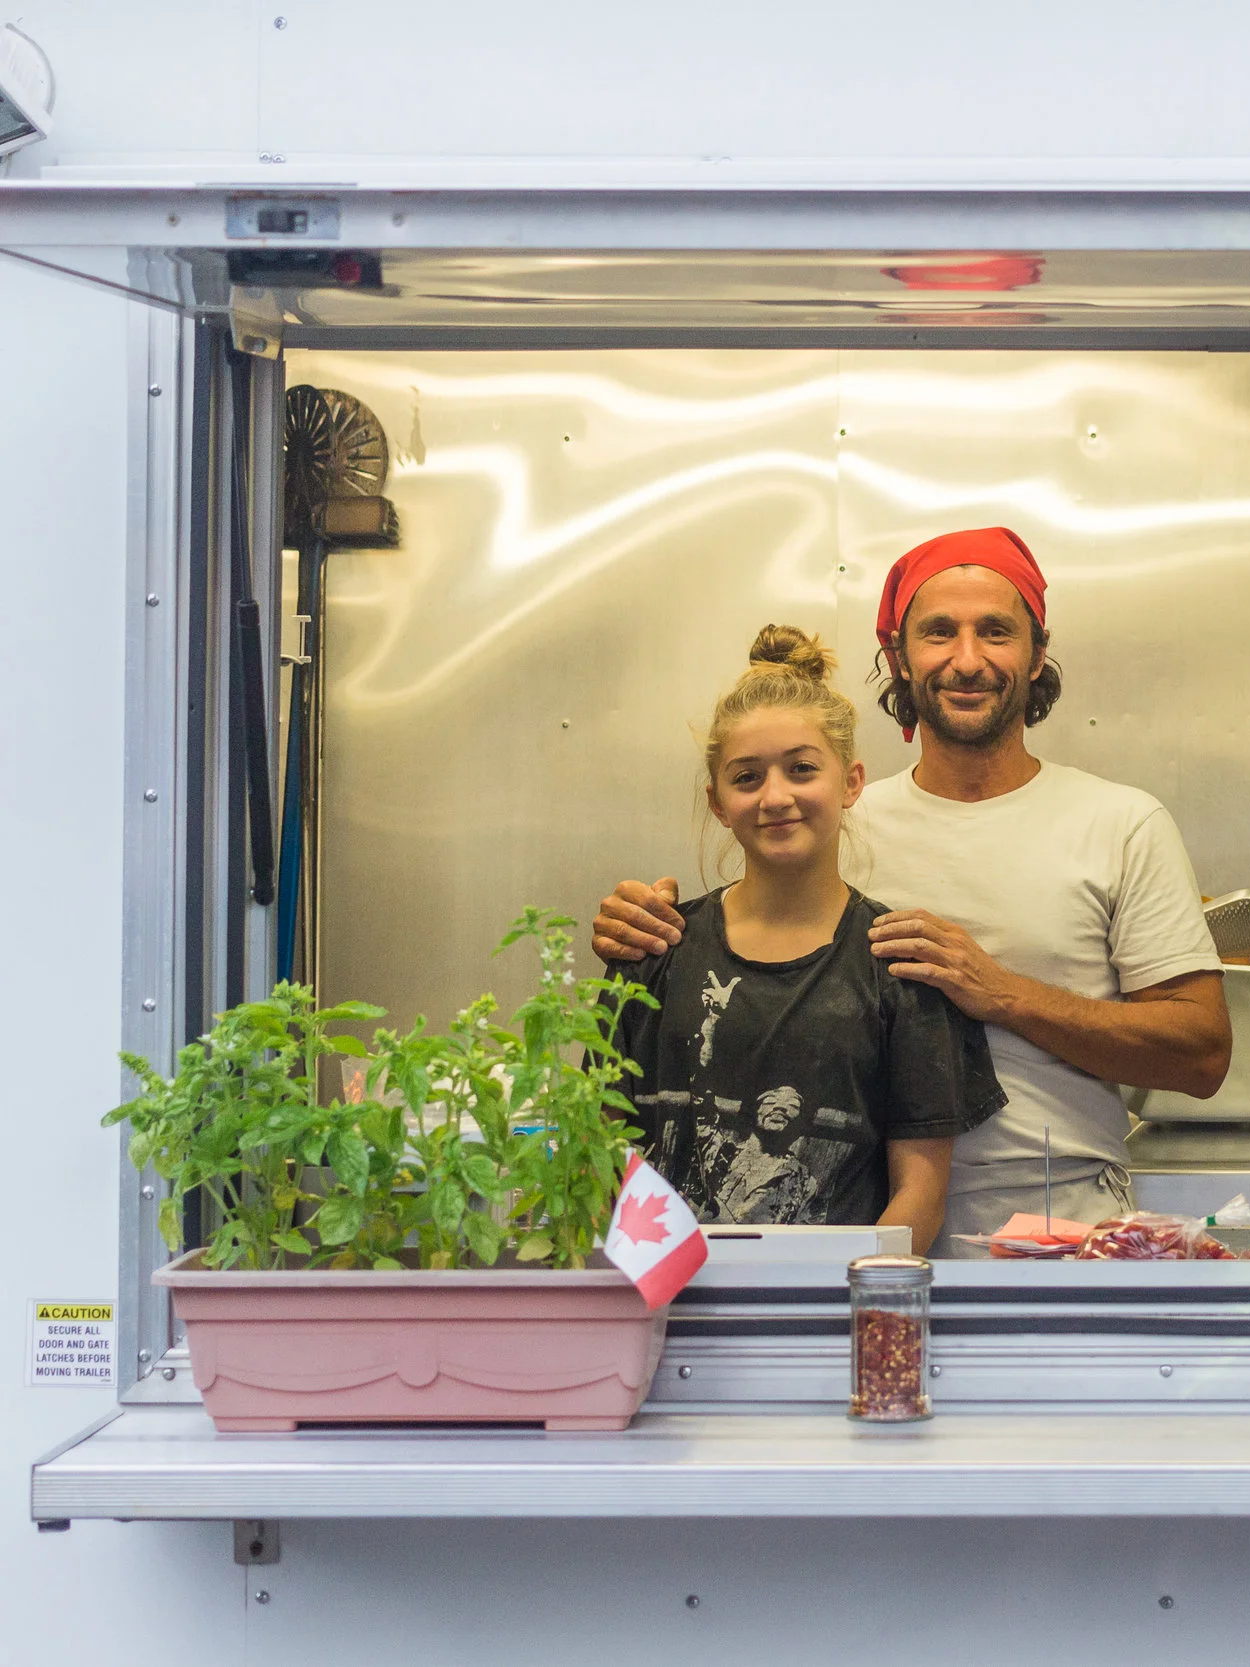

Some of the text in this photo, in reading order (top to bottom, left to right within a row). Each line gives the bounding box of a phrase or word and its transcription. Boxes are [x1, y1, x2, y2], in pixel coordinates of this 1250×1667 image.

[51, 1307, 111, 1319] CAUTION
[48, 1325, 101, 1335] SECURE ALL
[39, 1339, 110, 1349] DOOR AND GATE
[36, 1353, 111, 1363] LATCHES BEFORE
[36, 1367, 111, 1377] MOVING TRAILER
